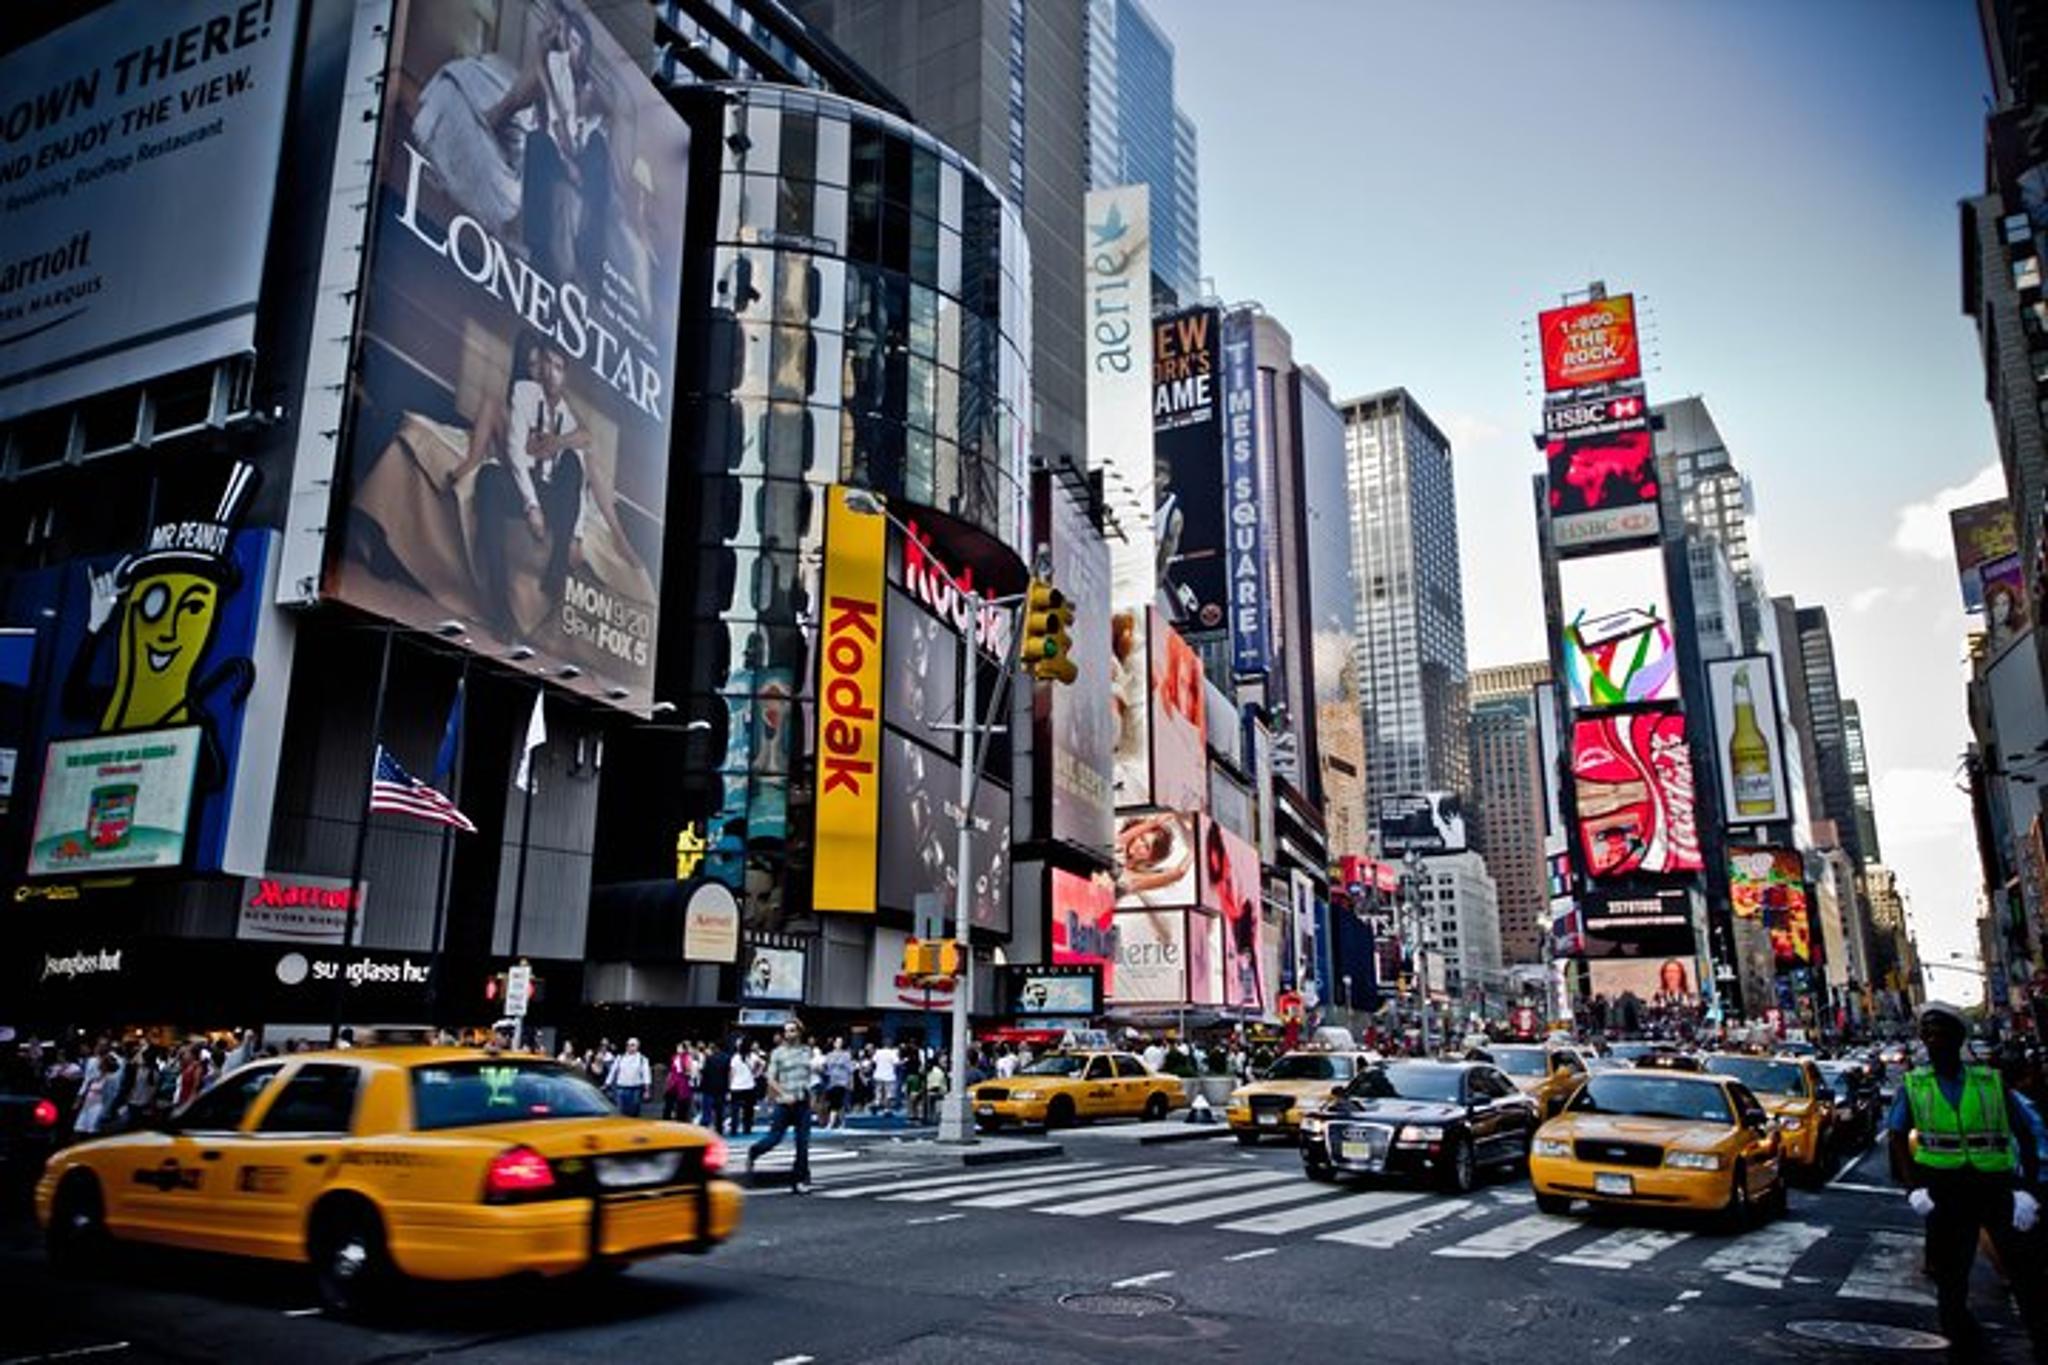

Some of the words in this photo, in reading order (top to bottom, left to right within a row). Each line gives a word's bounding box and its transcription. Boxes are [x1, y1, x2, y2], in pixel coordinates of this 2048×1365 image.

[0, 66, 100, 143] OWN
[113, 0, 272, 96] THERE!
[0, 155, 31, 184] ND
[36, 117, 115, 171] ENJOY
[121, 96, 171, 136] THE
[181, 65, 254, 114] VIEW.
[137, 118, 223, 164] Restaurant
[0, 229, 91, 294] arriott
[1094, 254, 1131, 373] aerie
[1157, 313, 1209, 360] EW
[1567, 328, 1607, 350] THE
[1152, 350, 1211, 384] ORK'S
[1154, 374, 1212, 417] AME
[1225, 342, 1252, 462] TIMES
[1546, 405, 1606, 430] HSBC
[176, 521, 229, 554] PEANUT
[1232, 477, 1258, 633] SQUARE
[565, 576, 613, 621] MON
[597, 622, 632, 661] FOX
[633, 641, 648, 667] 5
[824, 596, 877, 797] Kodak
[275, 912, 306, 924] YORK
[308, 914, 359, 928] MARQUS
